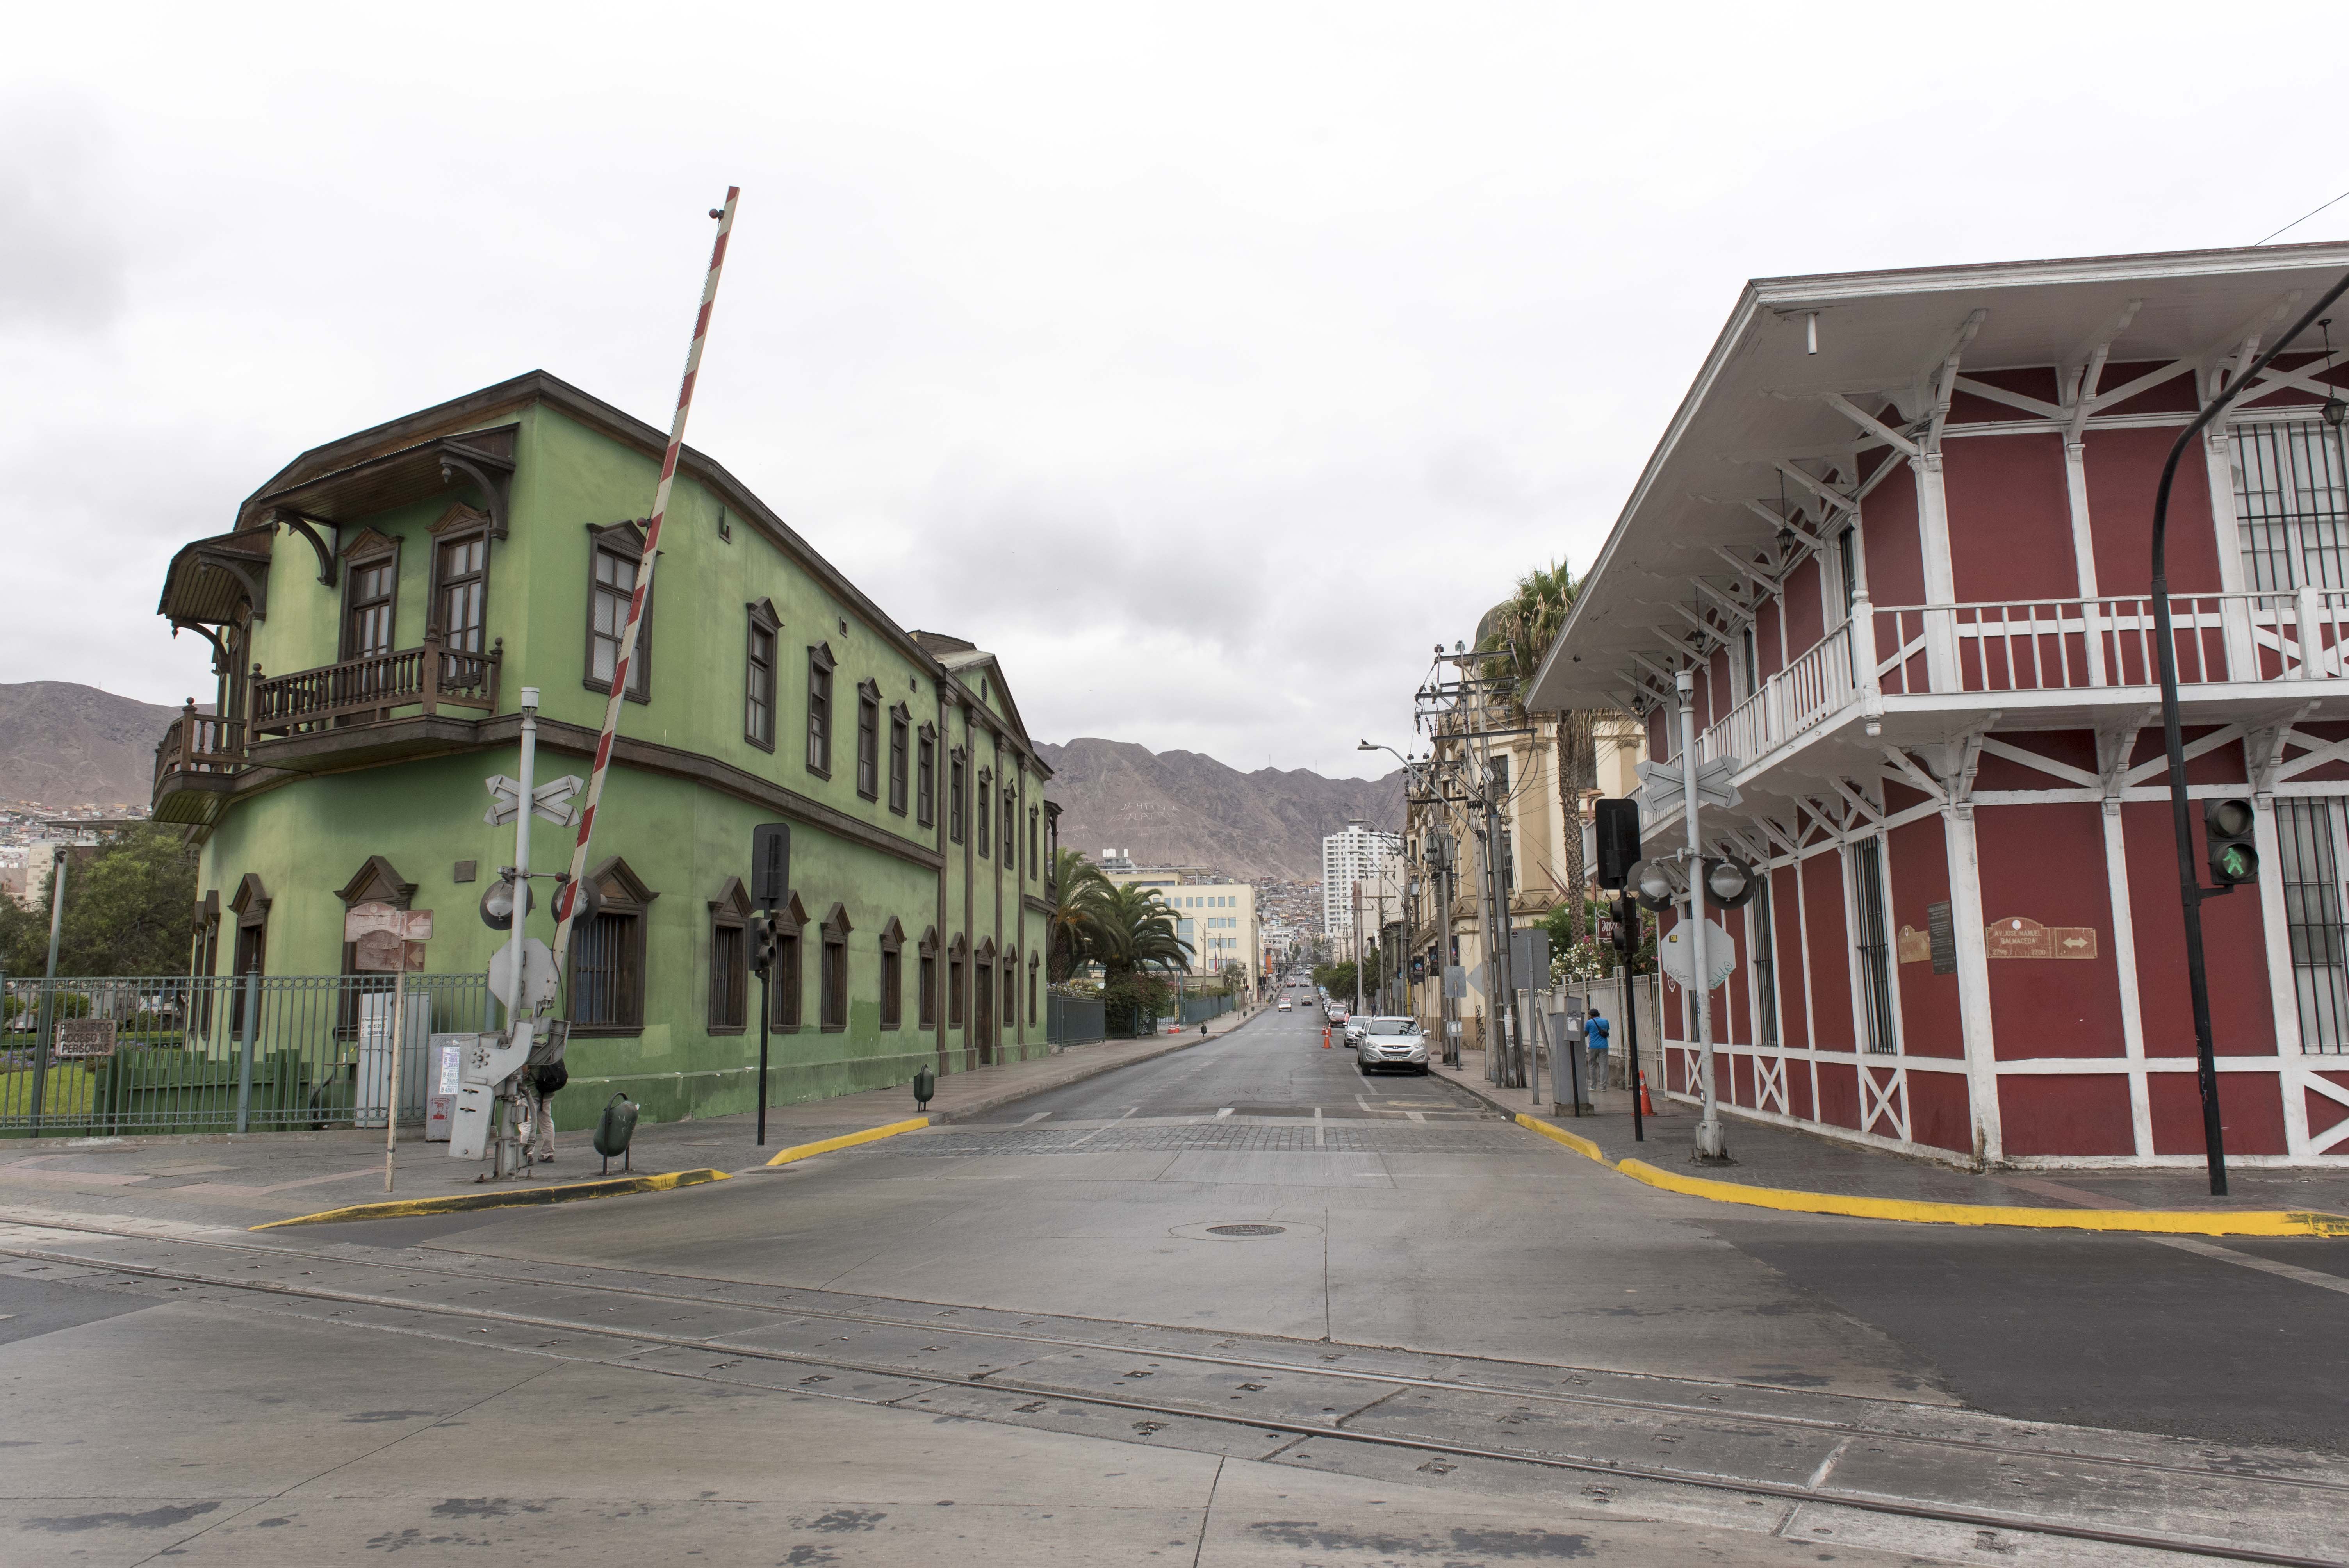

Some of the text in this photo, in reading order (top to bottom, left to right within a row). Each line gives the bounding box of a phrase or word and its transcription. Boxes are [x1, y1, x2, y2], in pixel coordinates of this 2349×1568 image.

[61, 1023, 114, 1032] PROHIBIDO
[61, 1033, 97, 1042] ACCESO
[62, 1043, 110, 1053] PERSONAS
